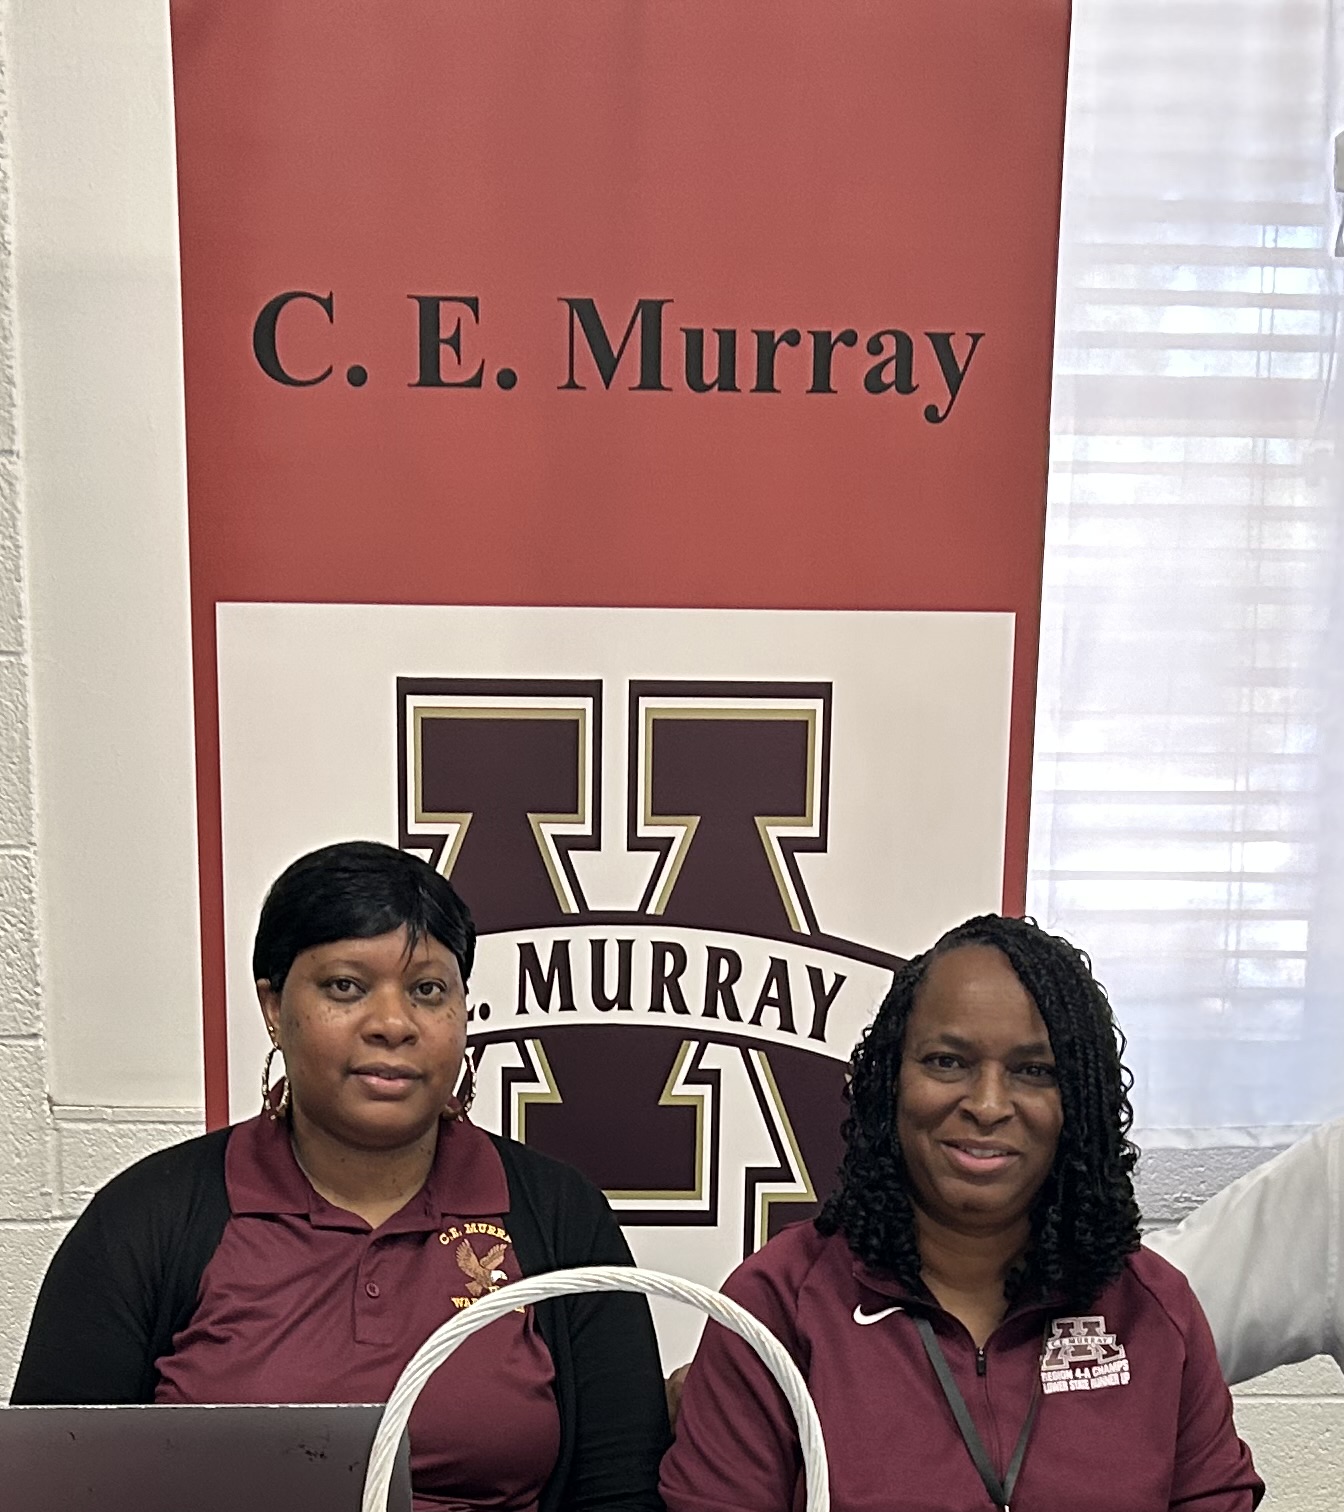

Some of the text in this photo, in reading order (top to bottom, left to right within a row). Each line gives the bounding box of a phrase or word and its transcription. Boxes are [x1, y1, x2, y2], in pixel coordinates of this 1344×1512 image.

[253, 290, 986, 424] C. E. Murray
[515, 938, 847, 1043] MURRAY
[464, 1222, 513, 1243] MURRA
